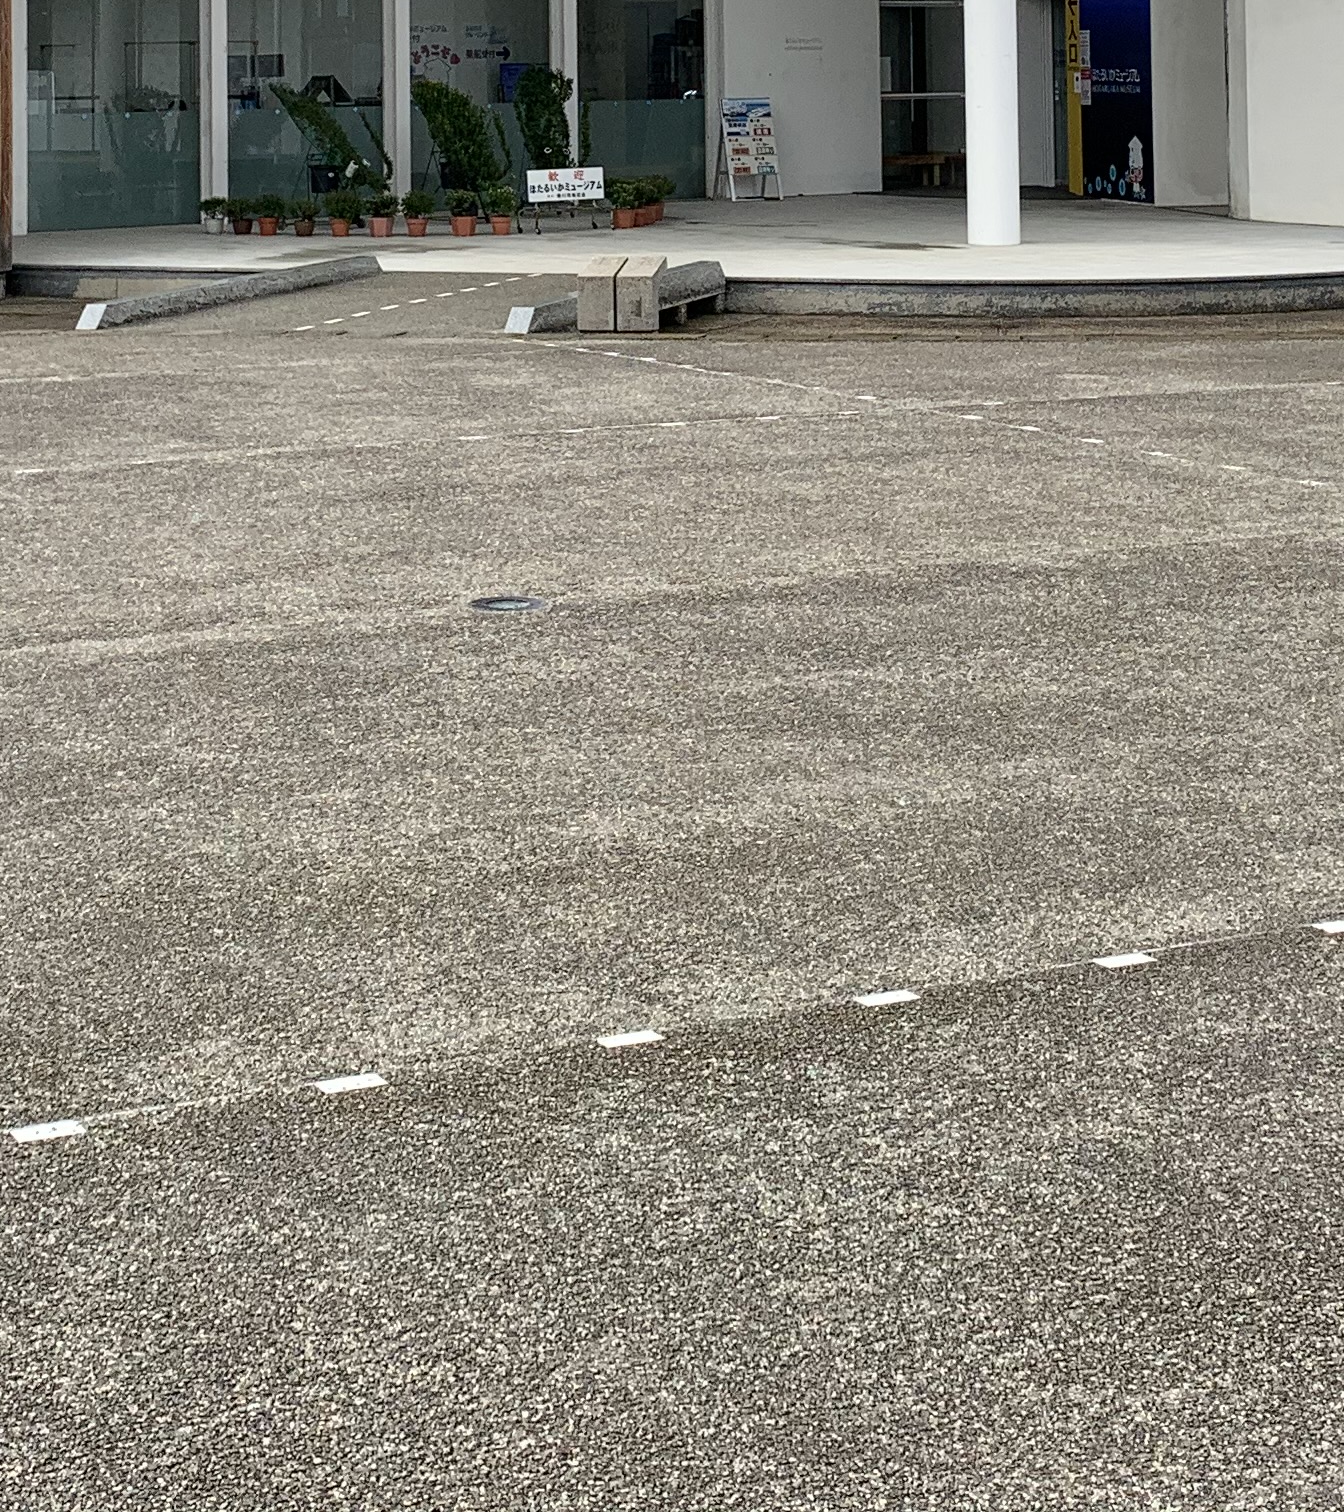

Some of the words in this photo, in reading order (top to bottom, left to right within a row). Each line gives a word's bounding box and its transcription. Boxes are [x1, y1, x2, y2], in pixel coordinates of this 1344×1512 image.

[529, 180, 603, 194] ほたるいかミュージアム
